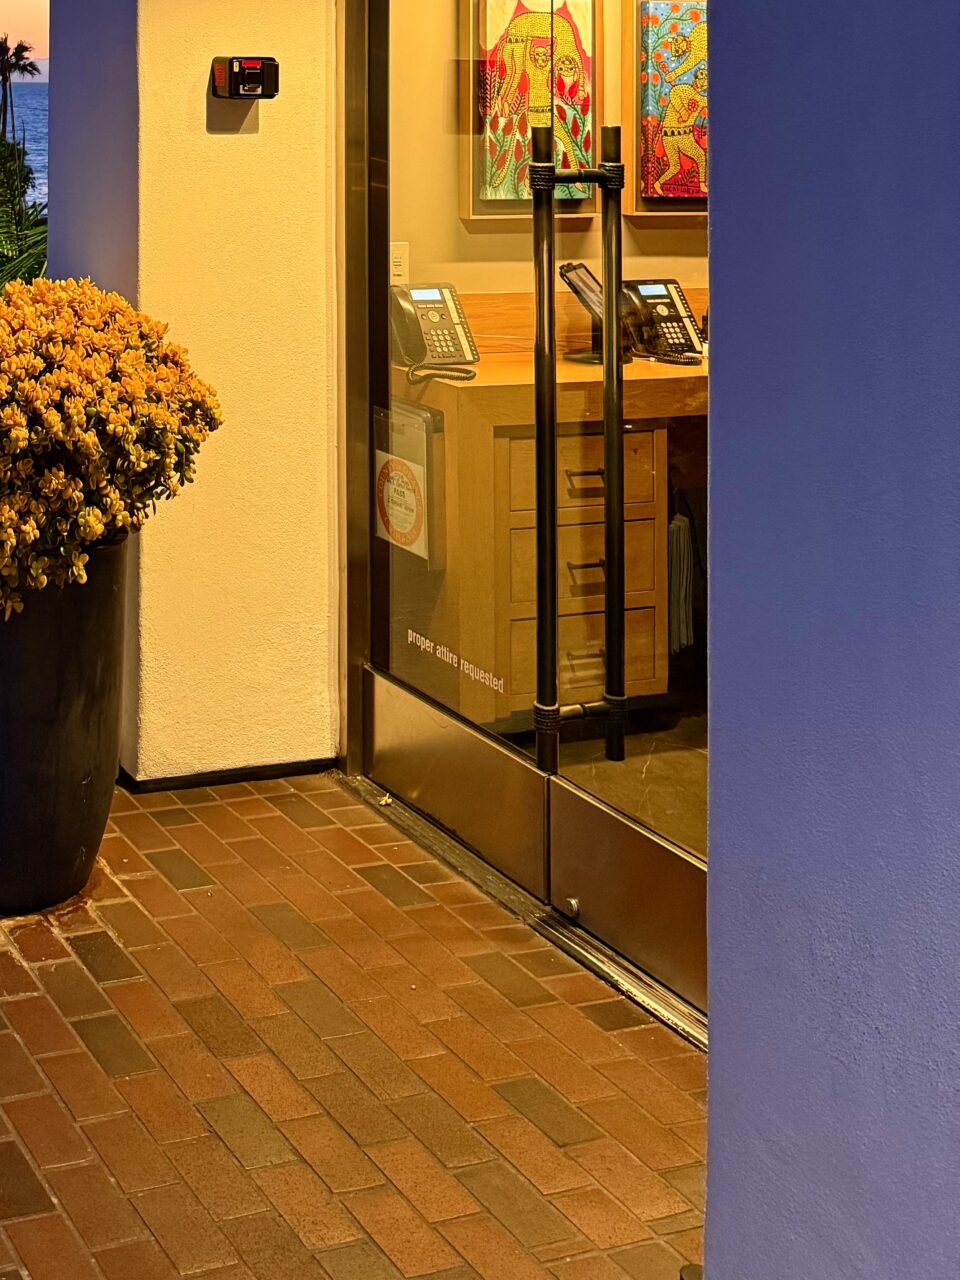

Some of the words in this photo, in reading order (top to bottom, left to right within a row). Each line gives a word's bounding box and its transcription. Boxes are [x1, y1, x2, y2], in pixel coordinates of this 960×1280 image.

[407, 628, 435, 655] proper
[436, 644, 459, 668] attire
[460, 657, 505, 694] requested
